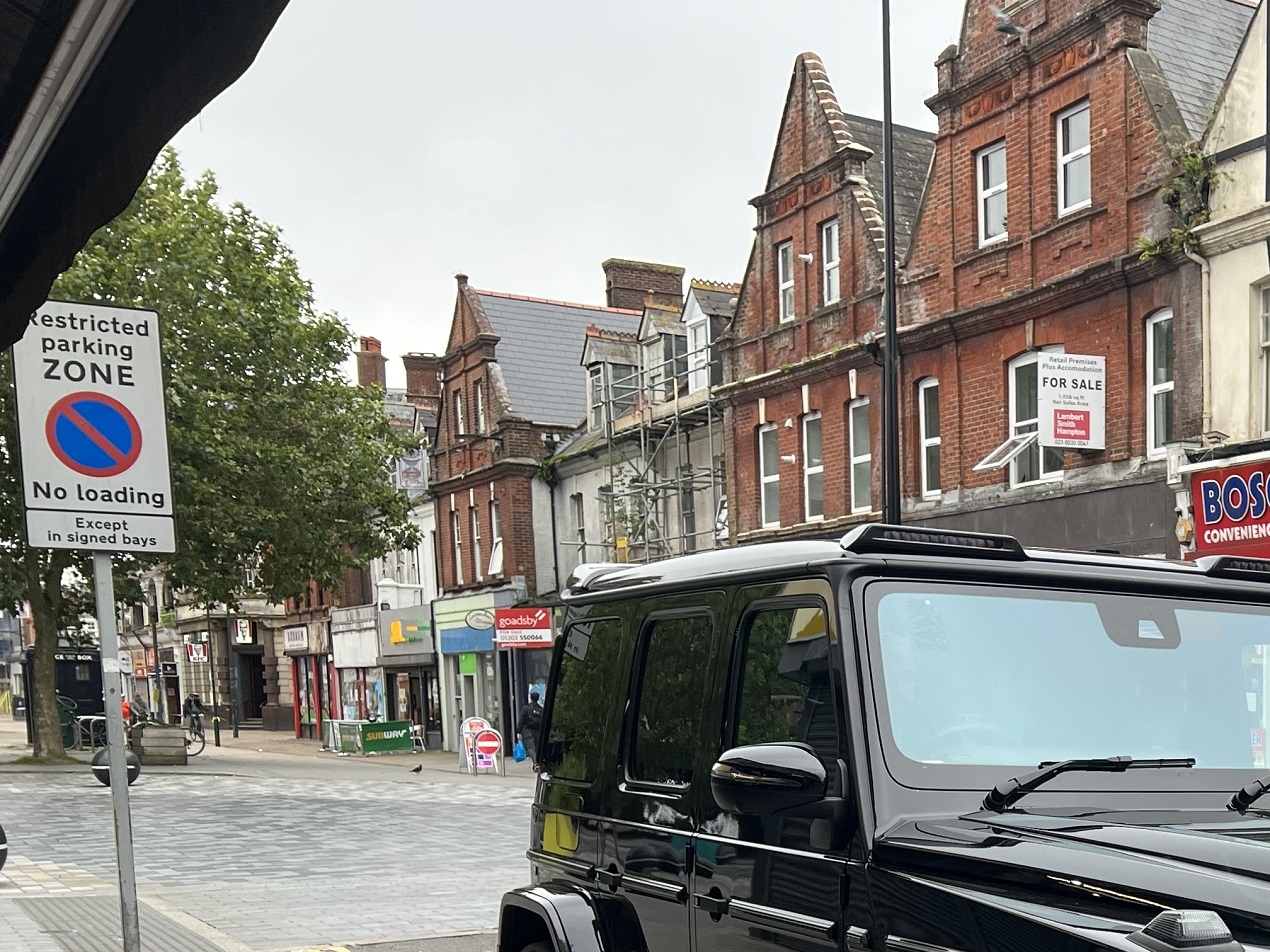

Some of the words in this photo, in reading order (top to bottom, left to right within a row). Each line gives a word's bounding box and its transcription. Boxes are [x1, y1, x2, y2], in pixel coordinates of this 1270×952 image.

[42, 337, 133, 361] parking
[43, 358, 135, 387] ZONE
[1043, 377, 1067, 388] FOR
[1072, 379, 1102, 390] SALE
[1057, 413, 1085, 421] Lambert
[1057, 428, 1086, 436] Hampton
[33, 481, 67, 500] No
[77, 484, 165, 508] loading
[75, 517, 128, 532] Except
[47, 531, 61, 542] in
[67, 533, 117, 546] signed
[122, 535, 157, 546] bays
[499, 615, 538, 628] goadsby
[365, 729, 407, 741] SUBWAY
